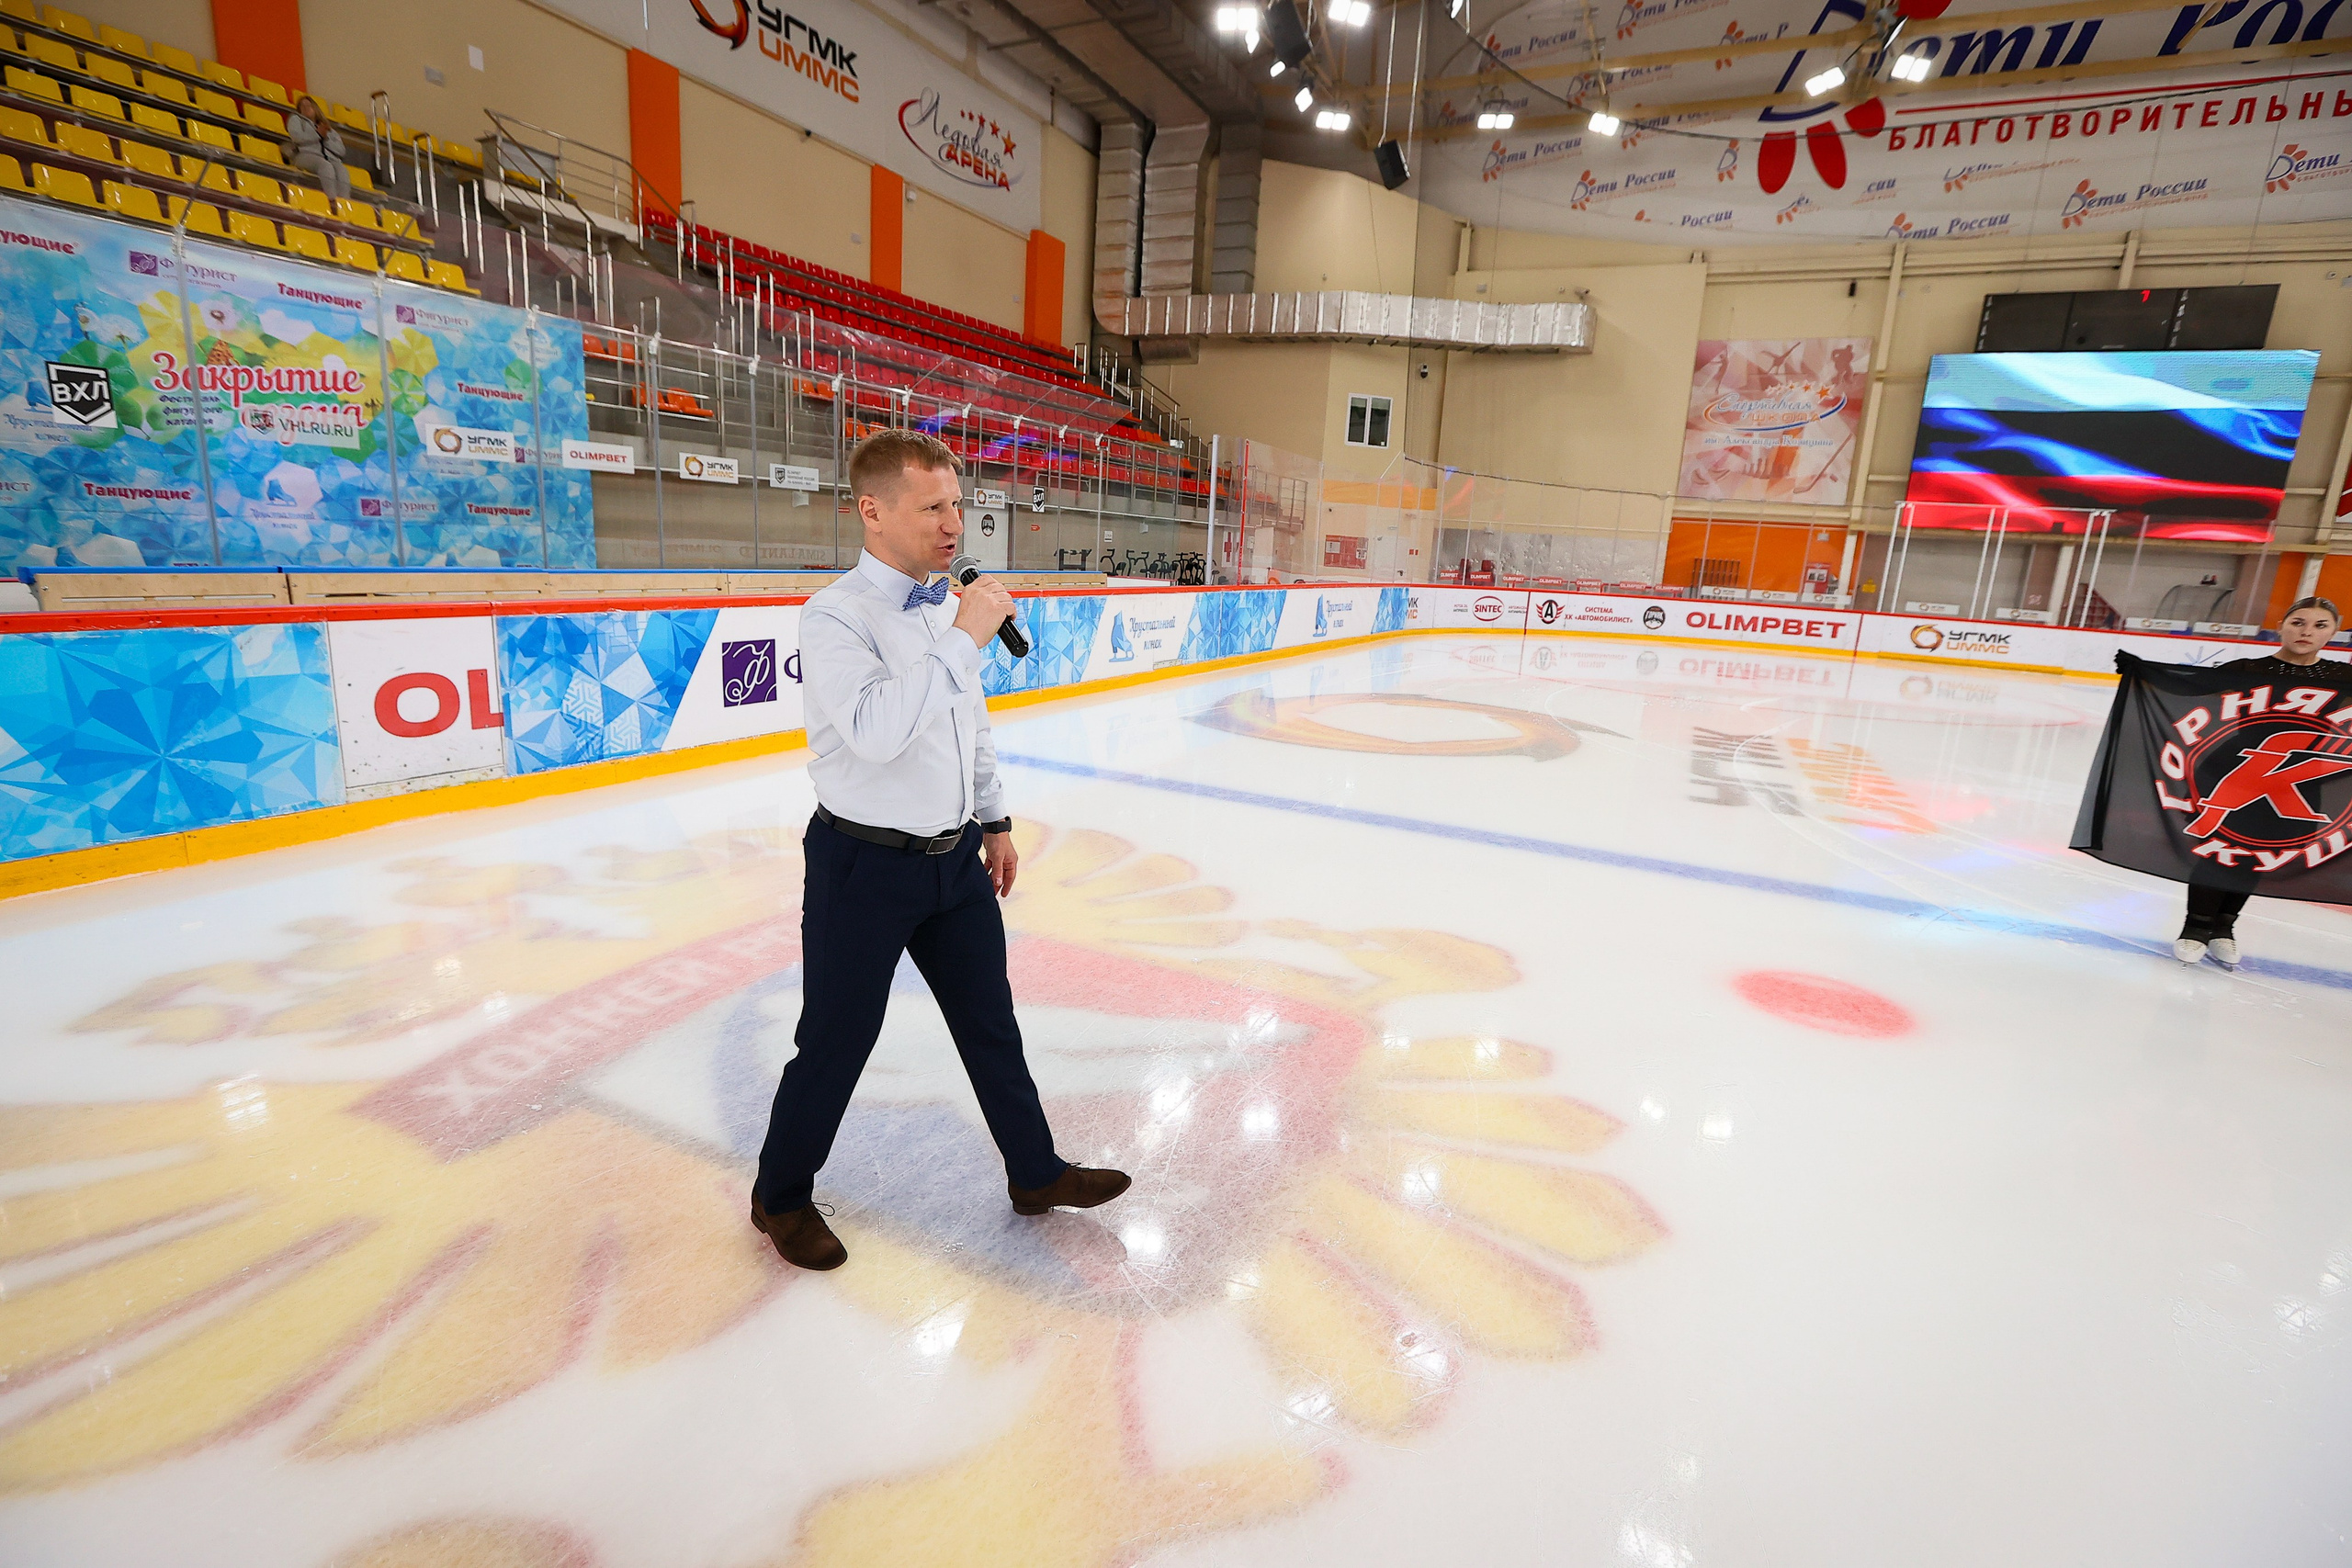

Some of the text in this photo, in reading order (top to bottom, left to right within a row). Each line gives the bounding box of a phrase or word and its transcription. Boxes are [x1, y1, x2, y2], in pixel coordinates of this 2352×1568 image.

[757, 0, 858, 78] УГМК
[758, 29, 859, 104] UMMC
[1533, 138, 1582, 157] России
[945, 143, 1011, 192] АРЕНА
[1625, 168, 1676, 187] России
[2134, 178, 2208, 200] России
[1681, 209, 1733, 227] России
[1947, 213, 2010, 235] России
[159, 257, 237, 283] Фгурист
[277, 282, 363, 310] Танцующие
[153, 352, 365, 408] Закрытие
[51, 380, 110, 403] ВХЛ
[458, 382, 524, 401] Танцующие
[279, 418, 354, 438] VHLRU.RU
[467, 435, 508, 446] УГМК
[468, 446, 508, 456] UMMC
[570, 450, 628, 464] OLIMPBET
[84, 482, 192, 501] Танцующие
[467, 503, 531, 516] Танцующие
[1474, 604, 1503, 614] SINTEC
[1574, 615, 1634, 624] «АВТОМОБИЛИСТ»
[1686, 612, 1846, 639] OLIMPBET
[1949, 630, 2013, 645] УГМК
[1946, 641, 2010, 655] UMMC
